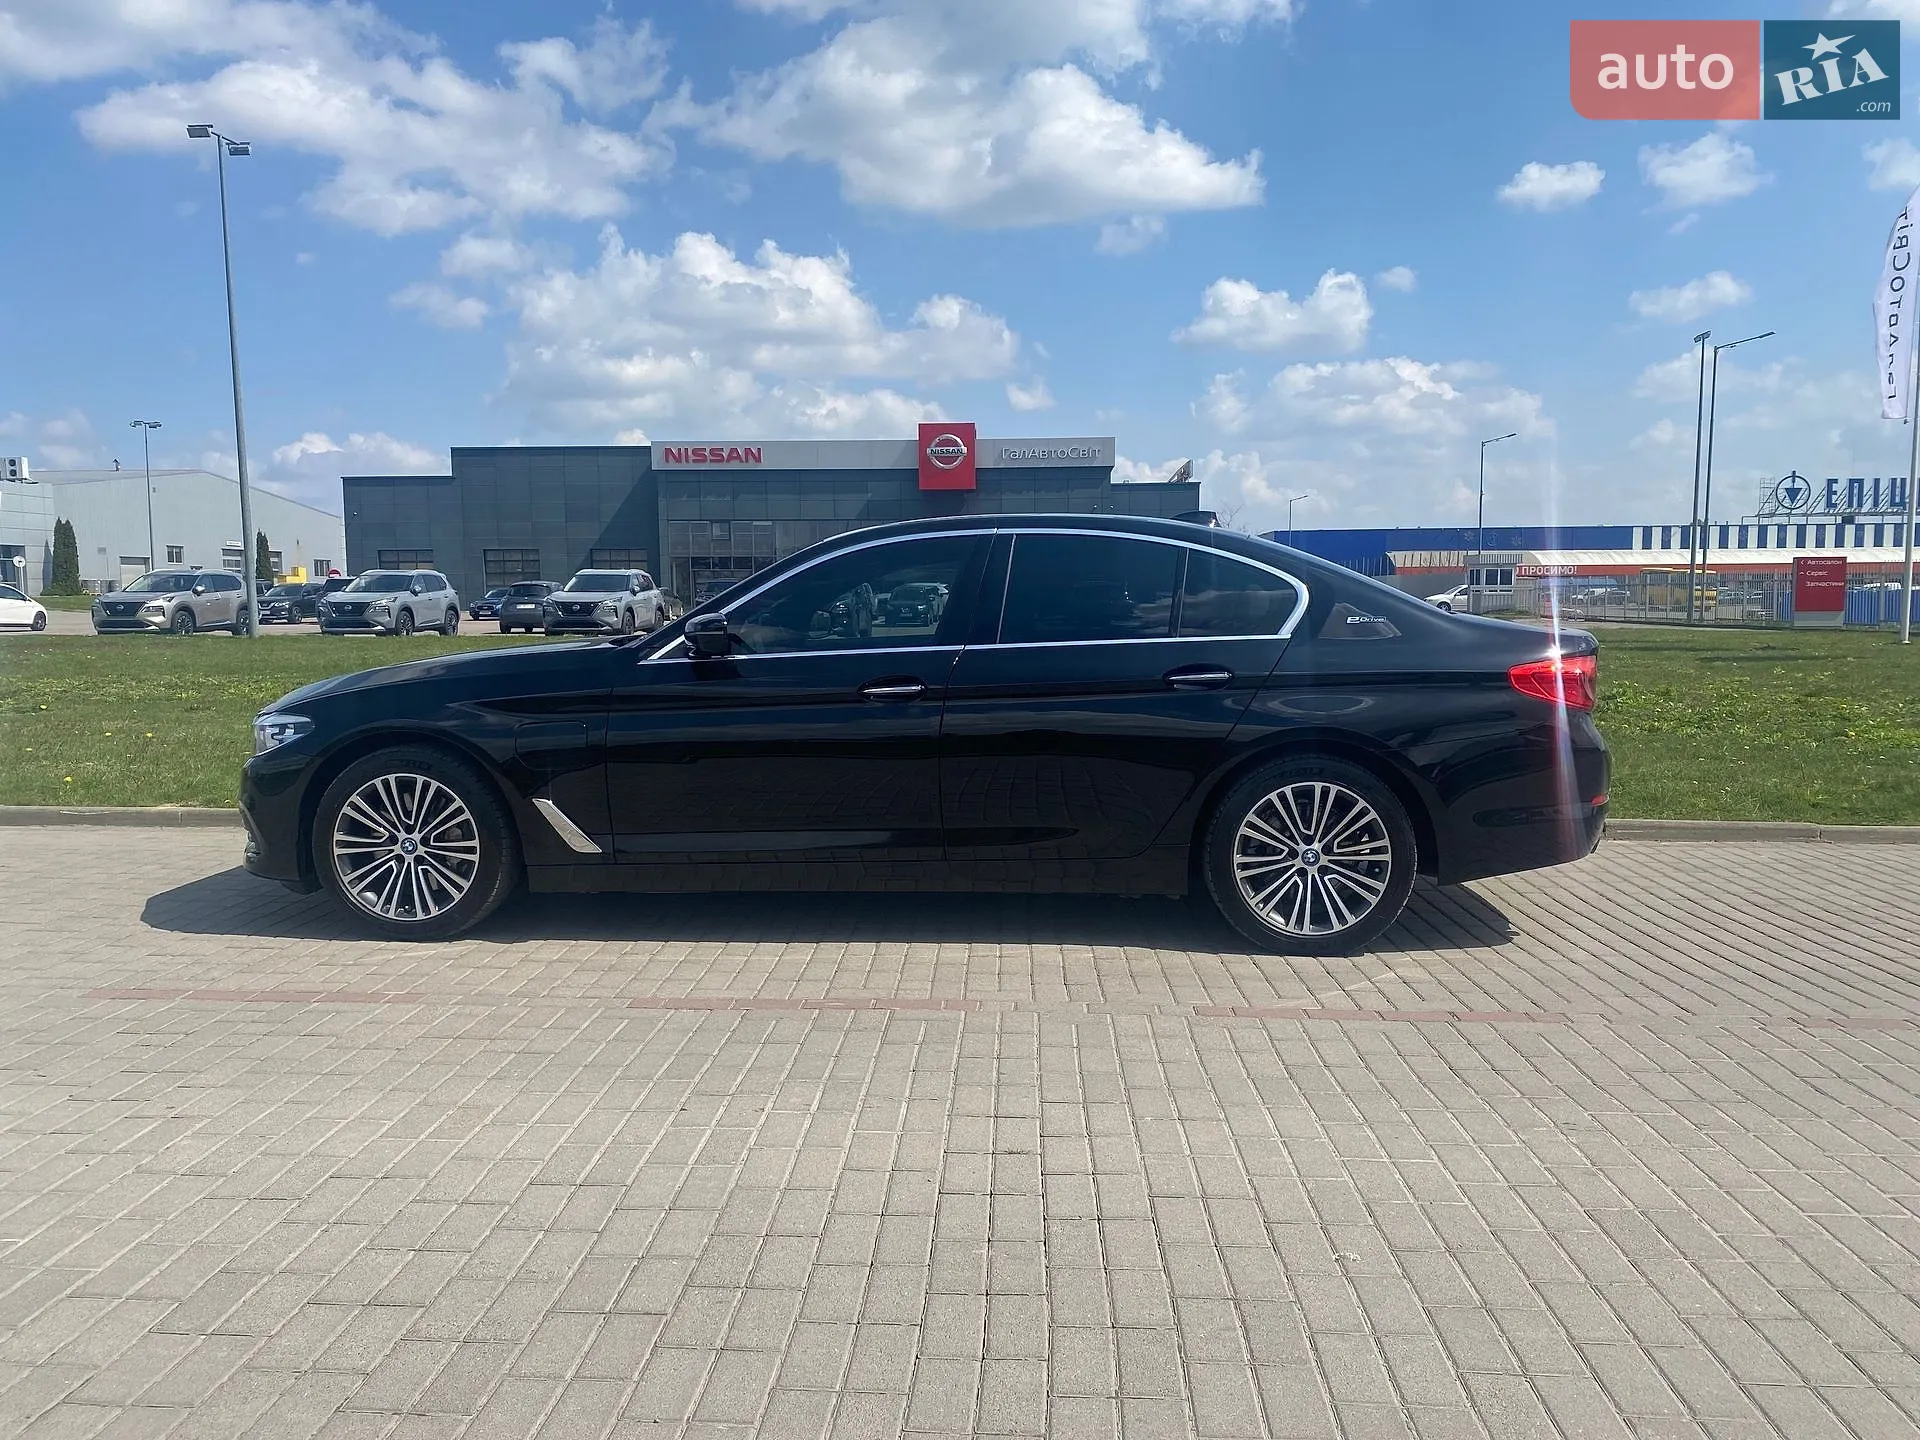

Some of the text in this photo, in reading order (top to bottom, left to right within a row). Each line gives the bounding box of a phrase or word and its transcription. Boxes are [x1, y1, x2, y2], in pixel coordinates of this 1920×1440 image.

[664, 447, 762, 463] NISSAN
[1001, 446, 1101, 459] ГалАвтоСвіт
[1826, 477, 1920, 510] ЕПІЦ
[1522, 566, 1577, 575] ПРОСИМО!
